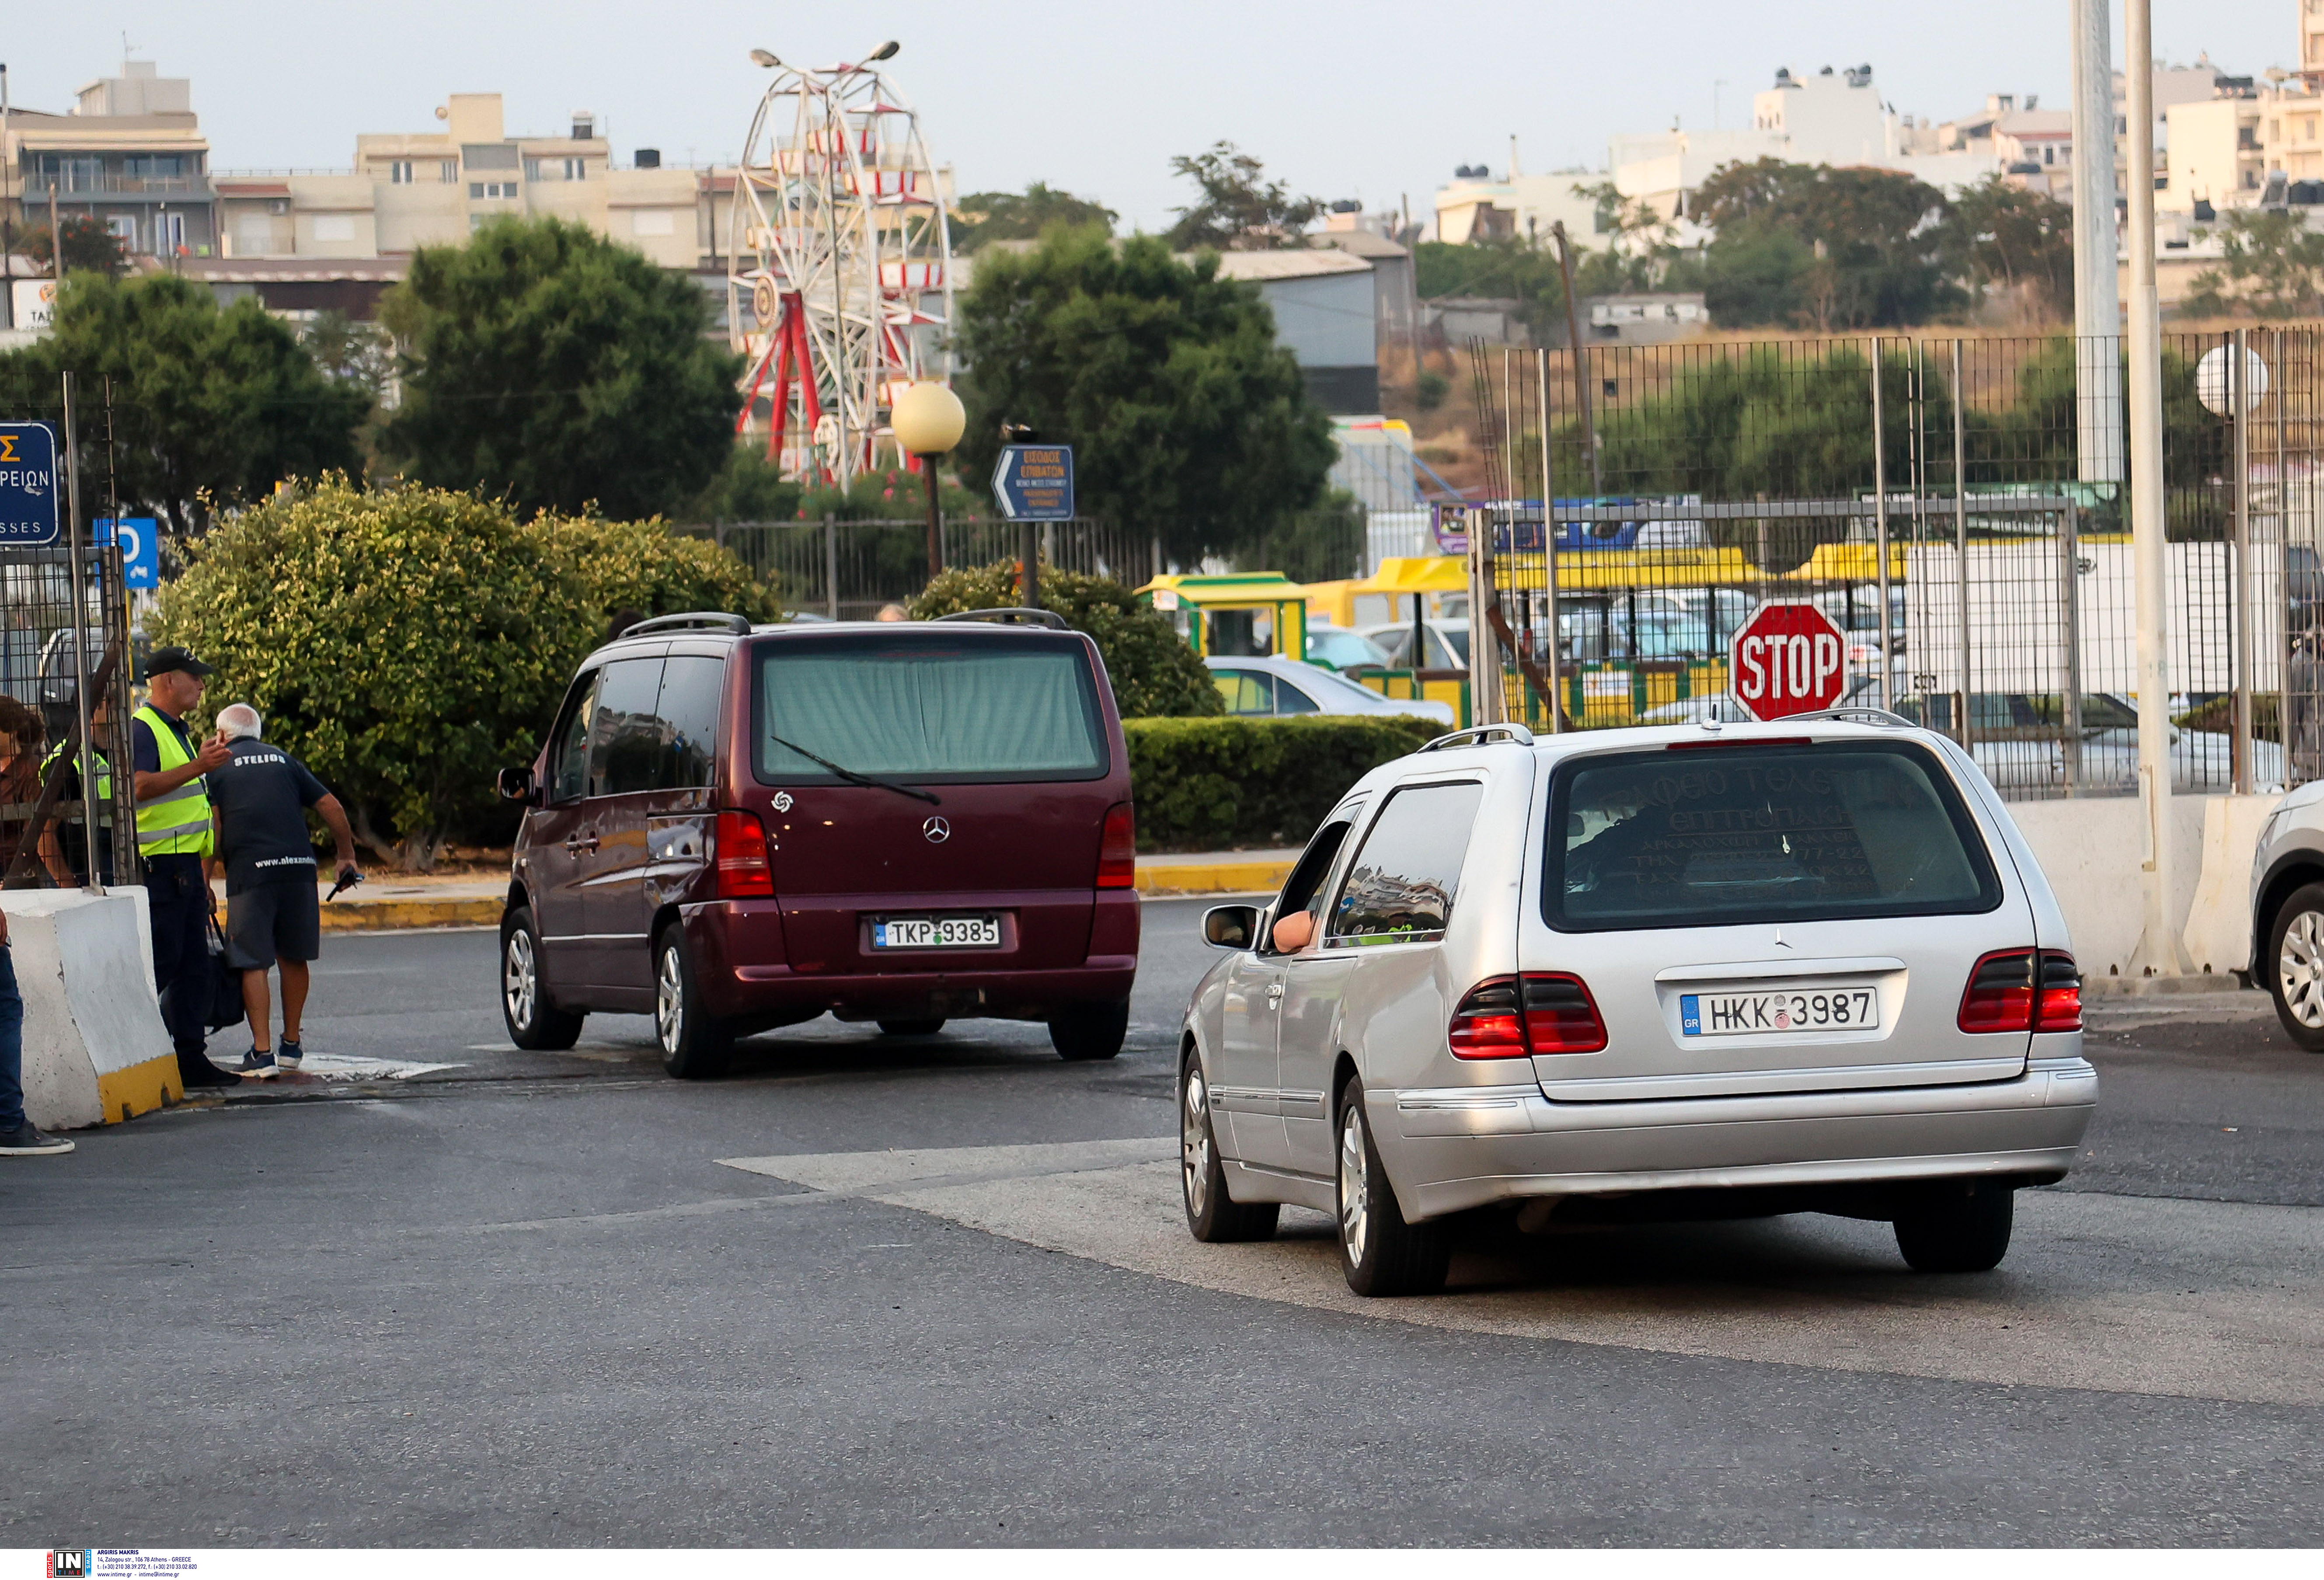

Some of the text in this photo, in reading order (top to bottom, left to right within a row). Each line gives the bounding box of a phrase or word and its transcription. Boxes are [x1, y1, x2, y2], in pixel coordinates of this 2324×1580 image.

[1742, 633, 1838, 700] STOP
[234, 754, 286, 766] STELIOS
[1684, 1019, 1699, 1028] GR
